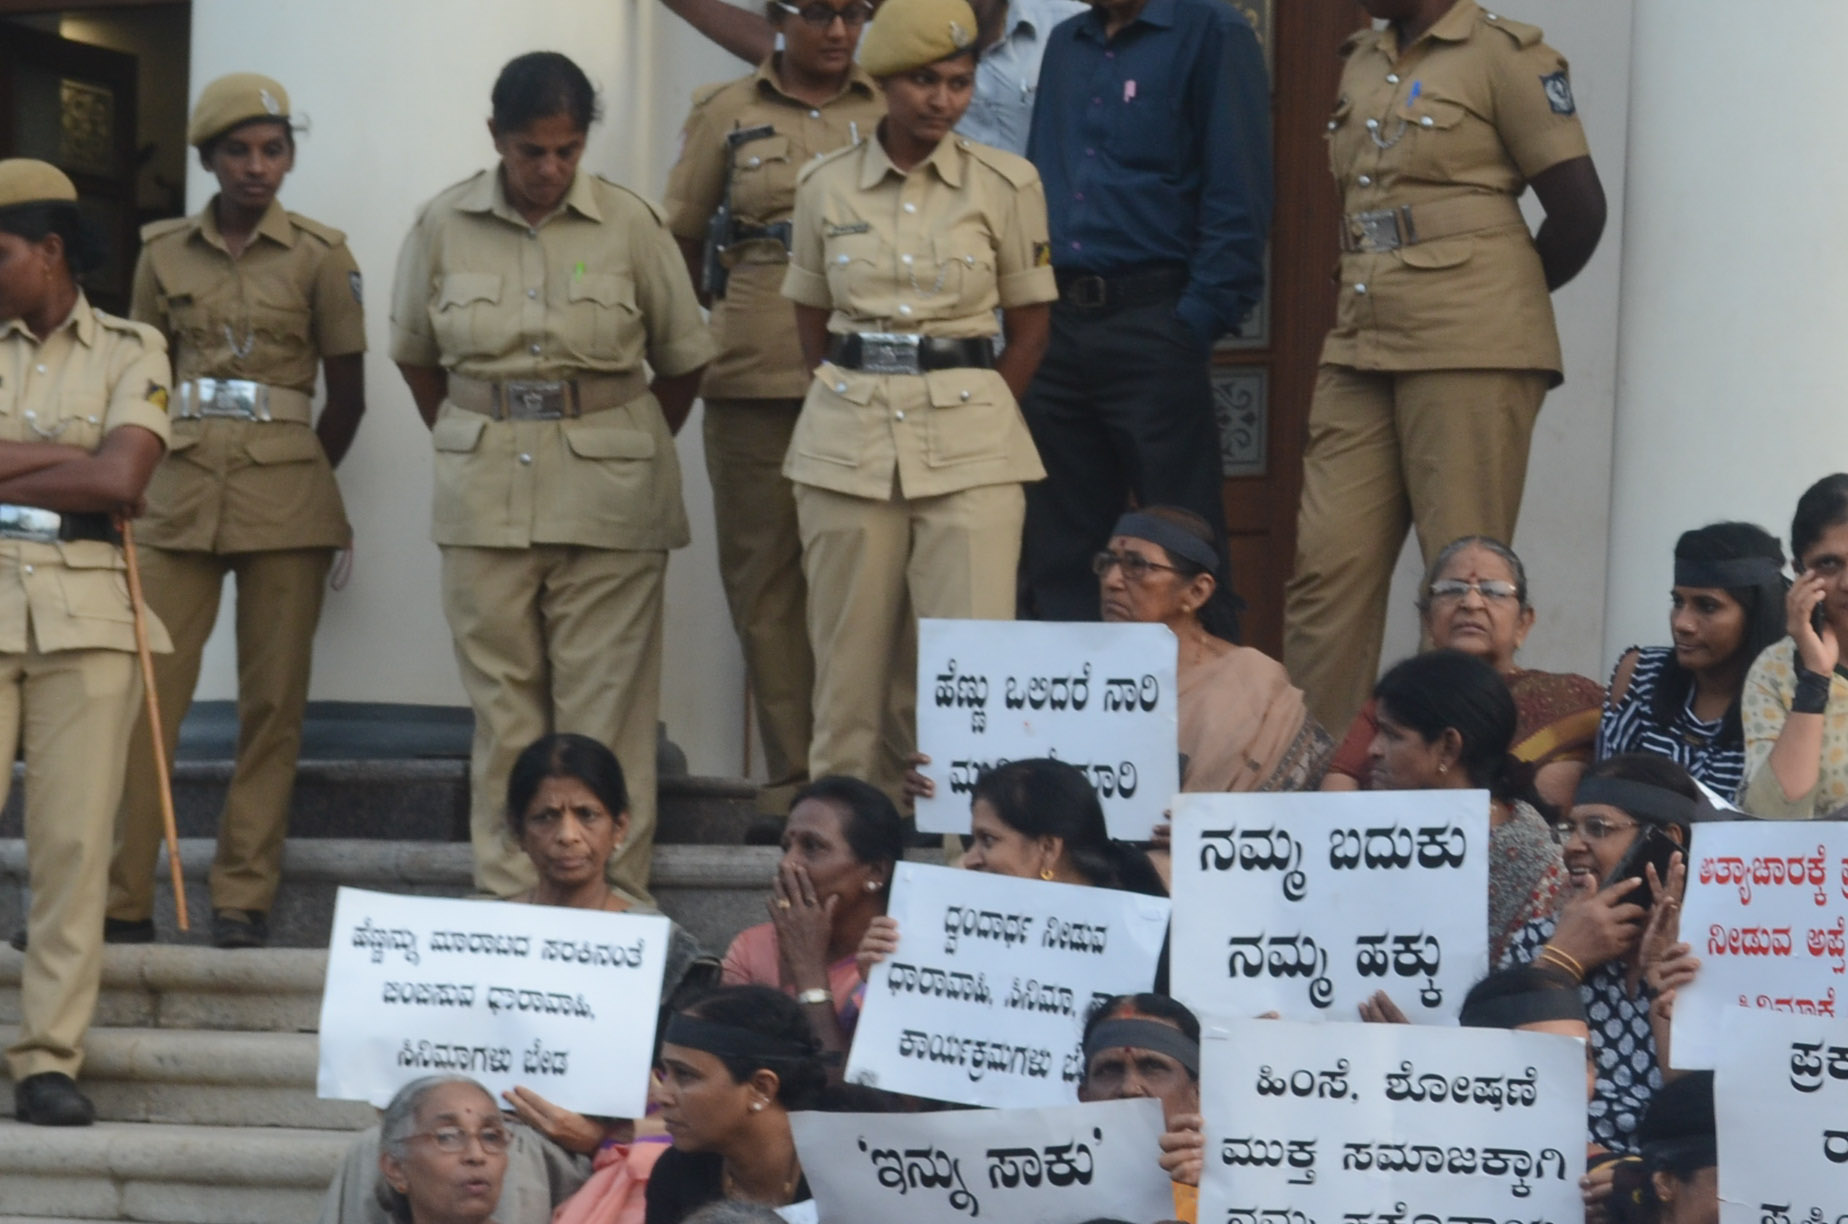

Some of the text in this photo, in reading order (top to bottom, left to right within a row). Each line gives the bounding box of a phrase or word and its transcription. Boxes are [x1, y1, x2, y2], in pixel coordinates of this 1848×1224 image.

[935, 658, 1159, 734] ಹೆಣ್ಣು ಒಲಿದರೆ ನಾರಿ
[1200, 821, 1466, 902] ನಮ್ಮ ಬದುಕು
[1699, 844, 1827, 906] ಅತ್ಯಾಚಾರಕ್ಕೆ
[1228, 930, 1443, 1009] ನಮ್ಮ ಹಕ್ಕು
[1708, 924, 1793, 956] ನೀಡುವ
[1256, 1058, 1539, 1113] ಹಿಂಸೆ, ಶೋಷಣೆ
[1221, 1136, 1567, 1198] ಮುಕ್ತ ಸಮಾಜಕ್ಕಾಗಿ
